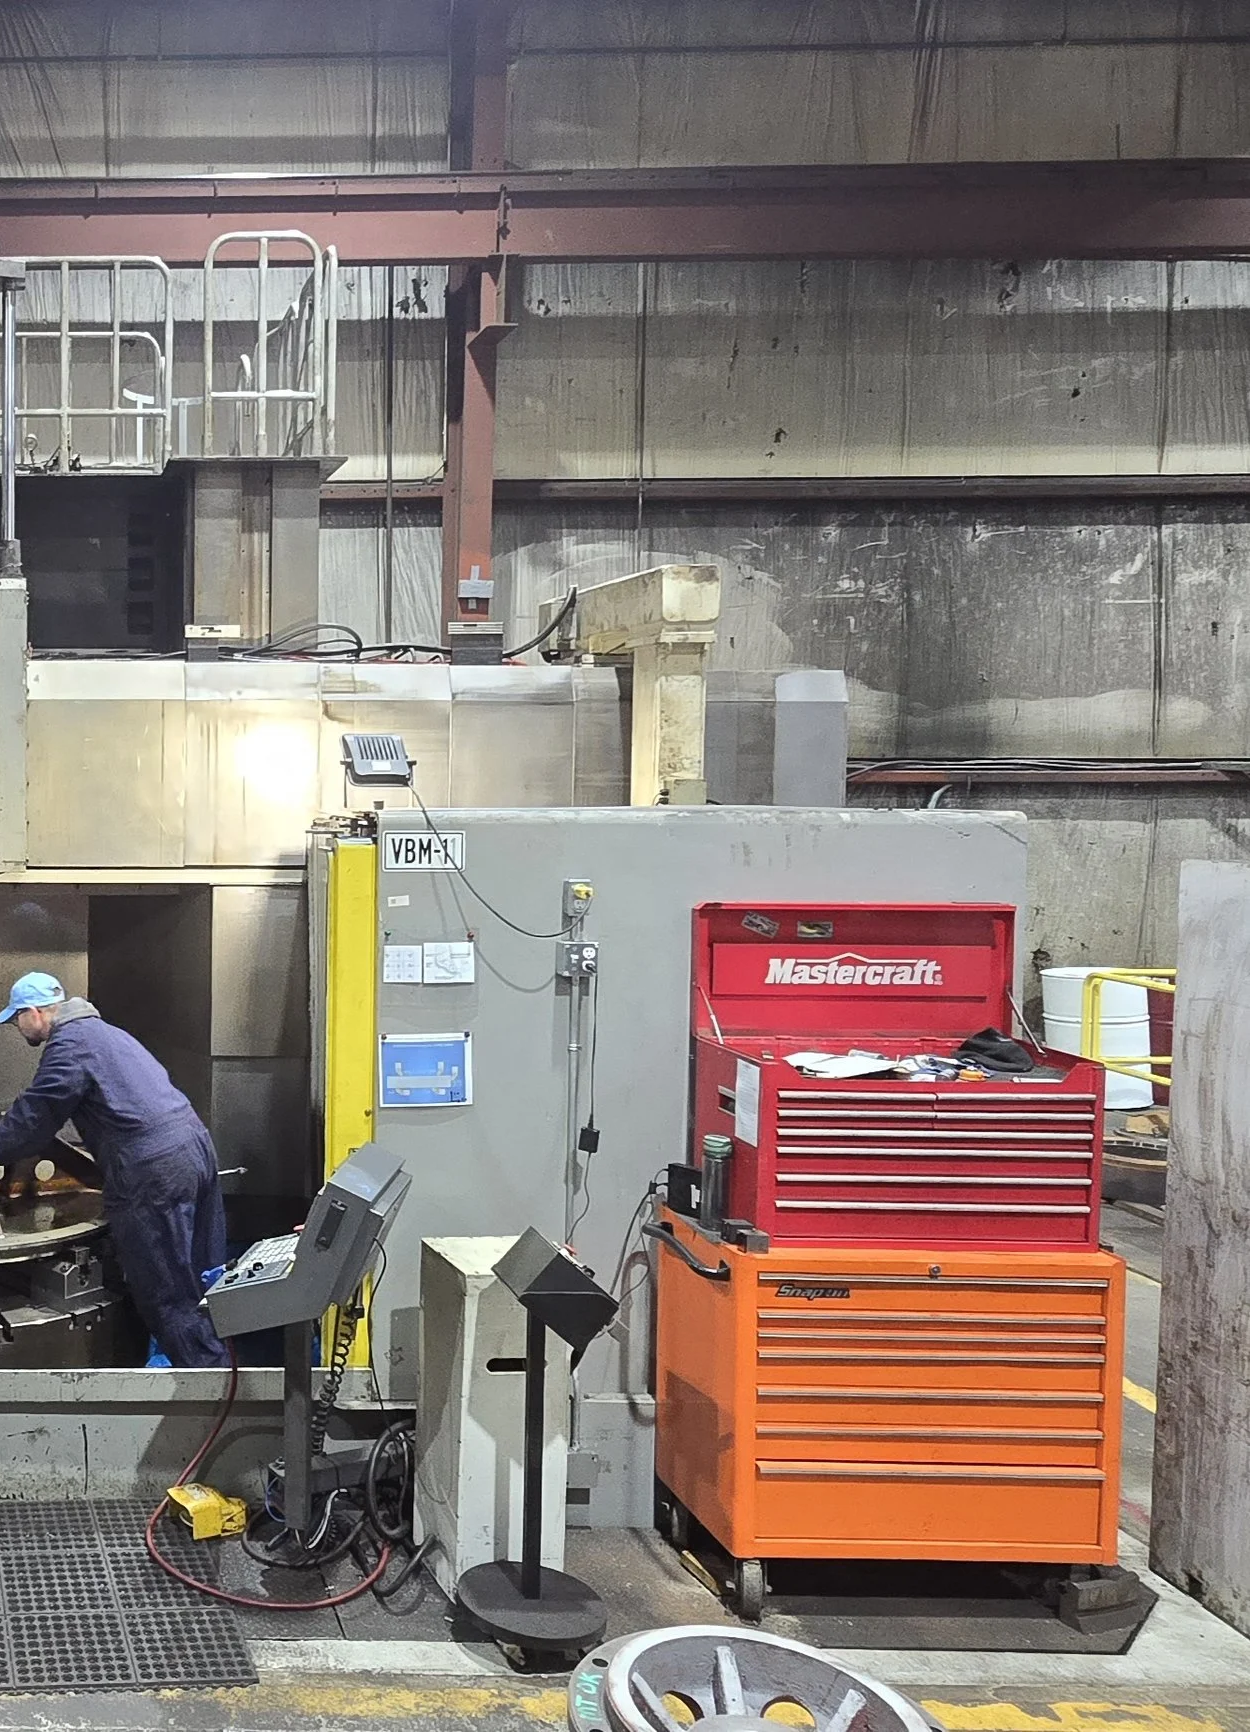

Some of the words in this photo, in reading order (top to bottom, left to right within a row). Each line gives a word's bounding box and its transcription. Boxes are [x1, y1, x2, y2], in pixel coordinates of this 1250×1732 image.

[391, 838, 449, 865] VBM-1
[764, 957, 942, 985] Mastercraft
[576, 1672, 603, 1694] OK
